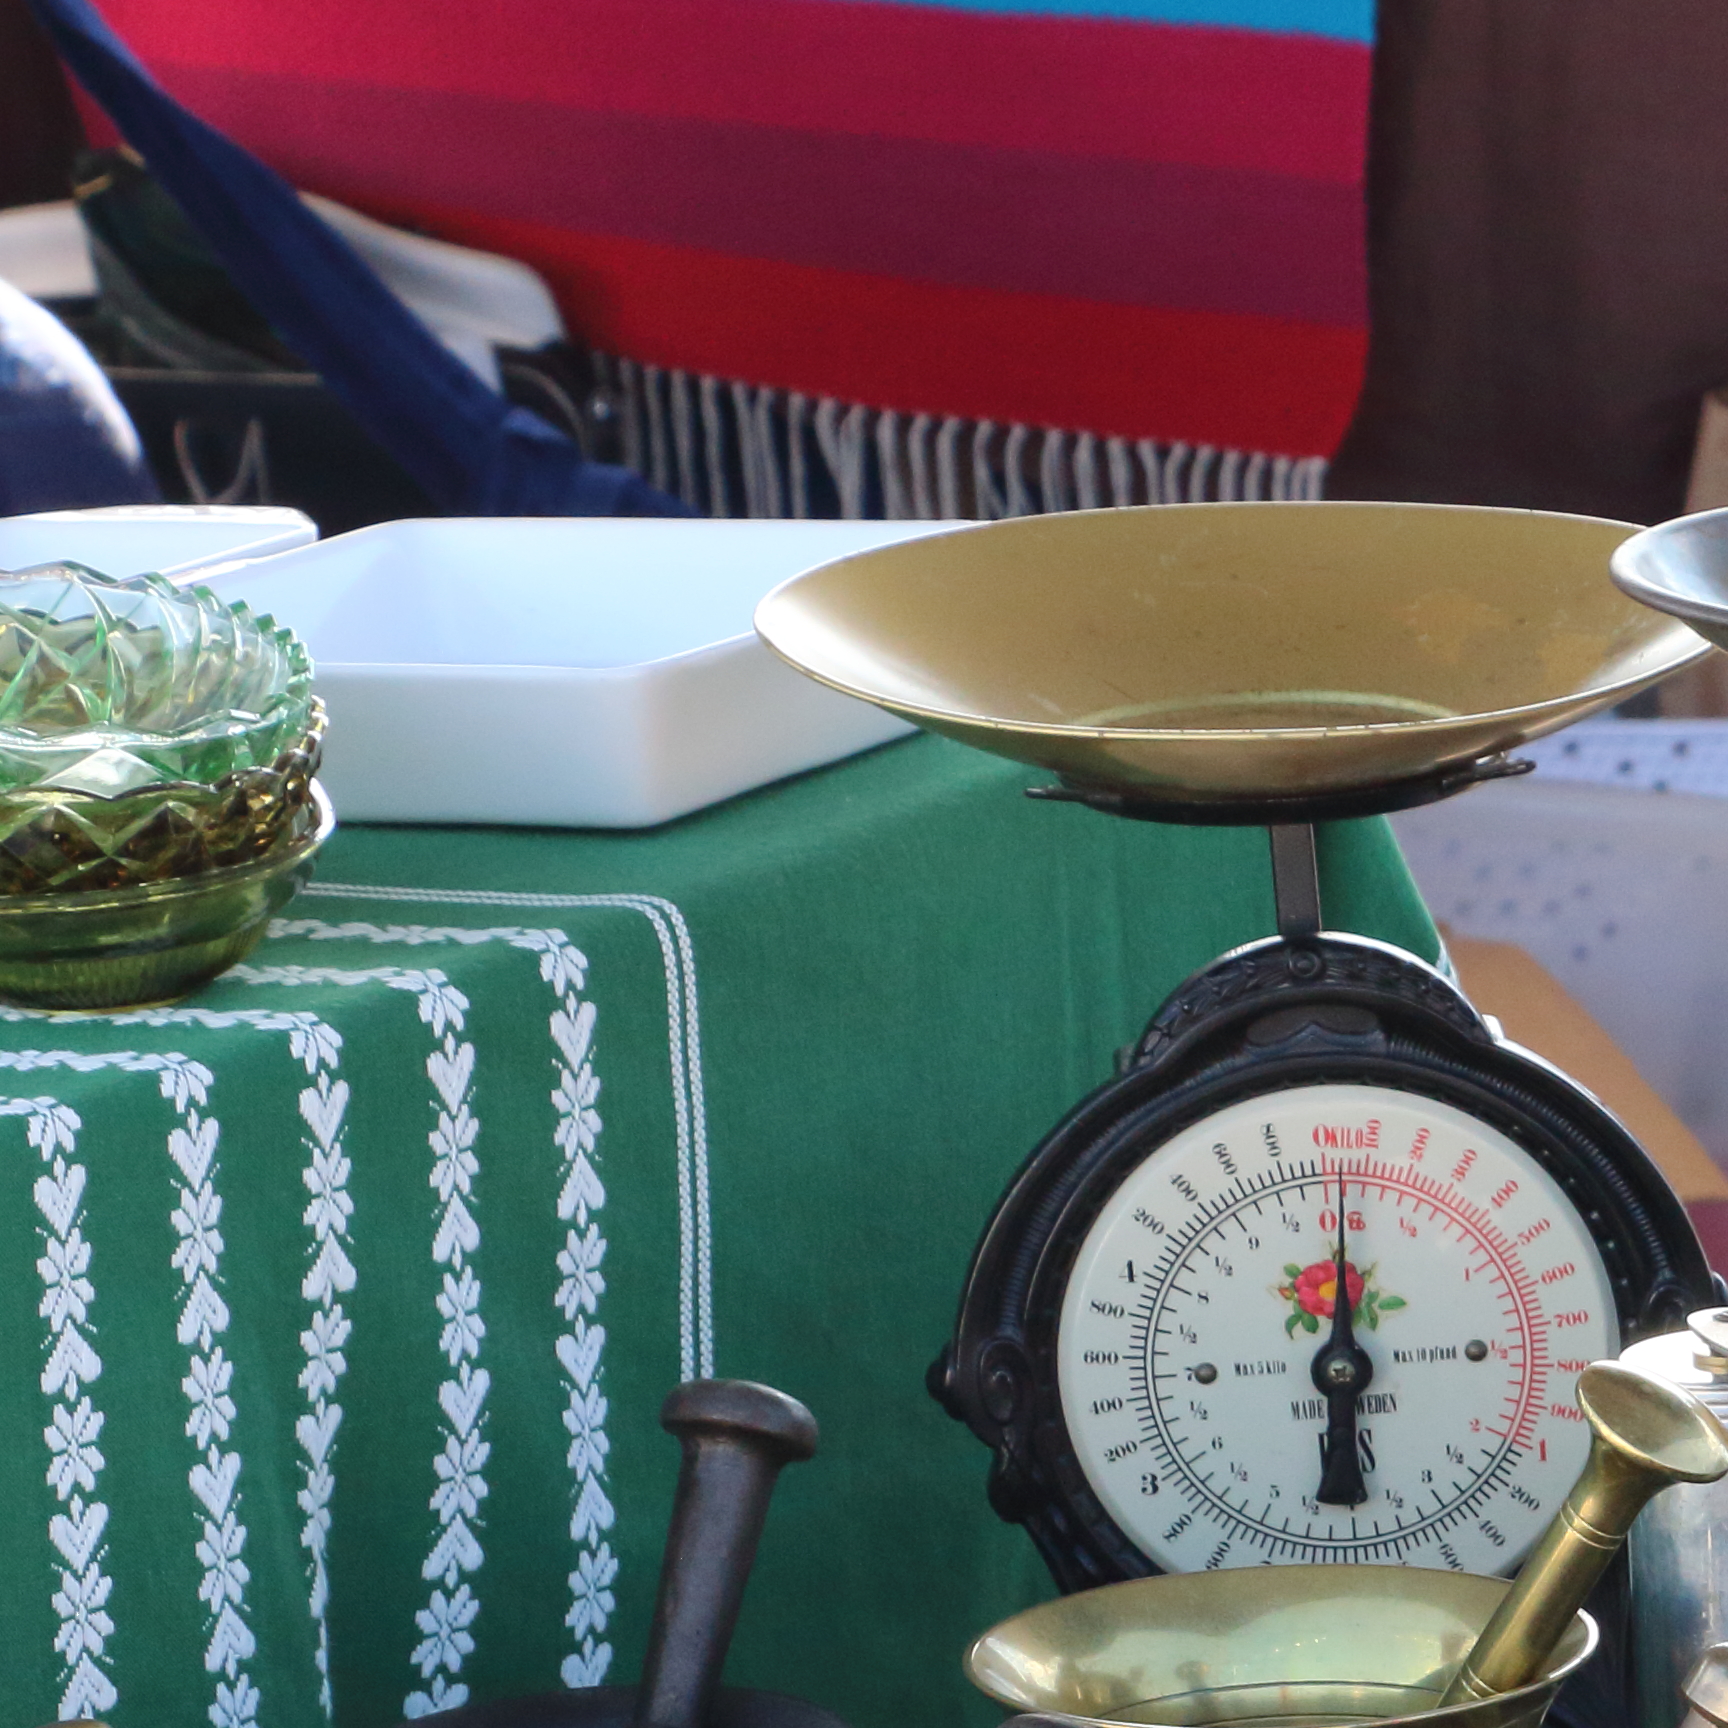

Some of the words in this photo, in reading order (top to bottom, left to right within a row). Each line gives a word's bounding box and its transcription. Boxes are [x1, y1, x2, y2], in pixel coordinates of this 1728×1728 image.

[1260, 1123, 1282, 1157] 800
[1330, 1126, 1363, 1149] KILO
[1363, 1119, 1382, 1149] 100
[1408, 1127, 1430, 1162] 200
[1212, 1142, 1238, 1176] 600
[1451, 1149, 1478, 1183] 300
[1169, 1172, 1199, 1202] 400
[1131, 1207, 1165, 1235] 200
[1517, 1218, 1551, 1246] 500
[1118, 1260, 1138, 1283] 4
[1540, 1262, 1575, 1285] 600
[1090, 1300, 1125, 1320] 800
[1553, 1310, 1589, 1328] 700
[1083, 1350, 1119, 1365] 600
[1089, 1397, 1123, 1416] 400
[1290, 1399, 1325, 1421] MADE
[1355, 1393, 1398, 1416] WEDEN
[1103, 1440, 1138, 1464] 200
[1140, 1472, 1160, 1496] 3
[1510, 1485, 1541, 1512] 200
[1161, 1513, 1193, 1542] 800
[1478, 1520, 1507, 1548] 400
